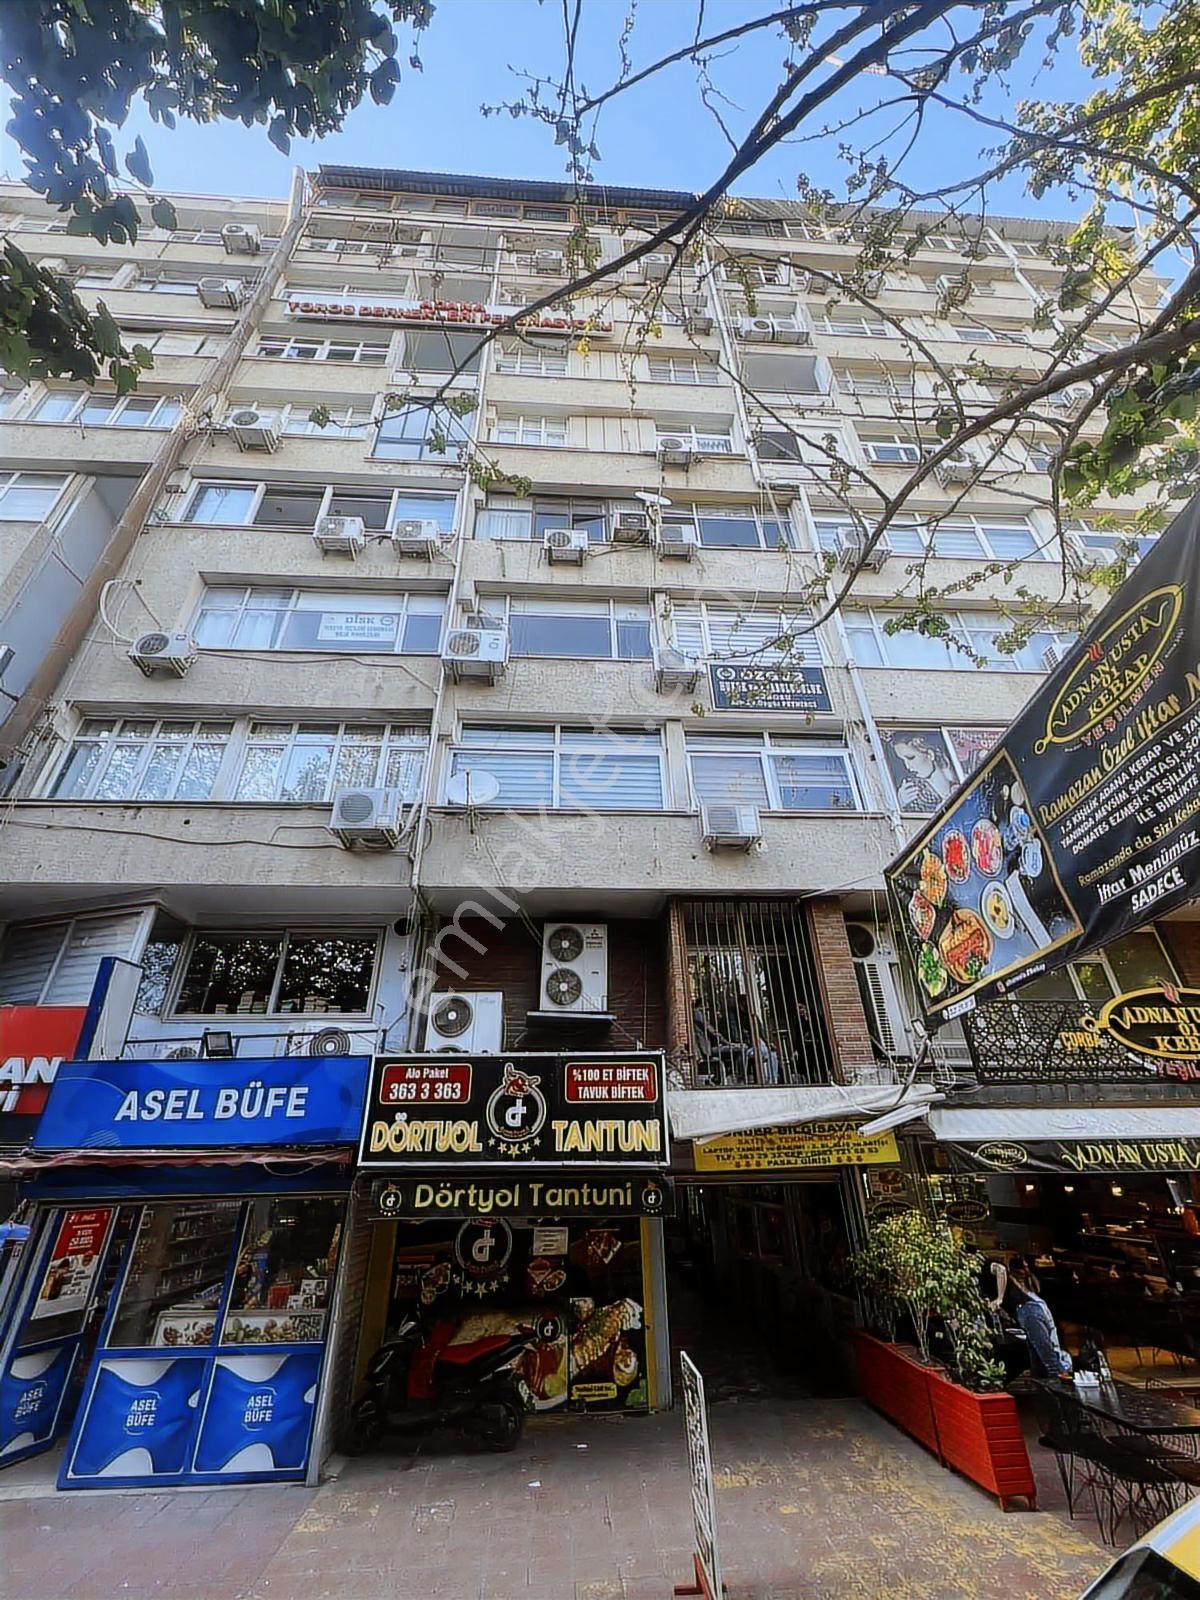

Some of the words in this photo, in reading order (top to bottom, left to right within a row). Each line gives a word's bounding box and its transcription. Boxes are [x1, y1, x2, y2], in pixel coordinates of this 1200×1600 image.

[288, 302, 355, 316] TOROS
[1053, 655, 1110, 728] ADNAN
[1109, 601, 1168, 662] USTA
[1088, 653, 1149, 719] KEBAP
[1100, 773, 1130, 801] ADANA
[1129, 744, 1162, 776] KEBAP
[1162, 731, 1184, 748] VE
[1039, 765, 1102, 826] Ramazan
[1094, 791, 1130, 821] MEVSİM
[1135, 806, 1157, 825] İLE
[1155, 773, 1199, 813] BİRLİKTE
[1072, 823, 1110, 855] DOMATES
[1129, 830, 1200, 884] Menümüz
[1131, 866, 1185, 911] SADECE
[1109, 1006, 1191, 1030] ADNAN
[405, 1068, 421, 1079] Alo
[572, 1069, 600, 1081] %100
[602, 1069, 614, 1081] ET
[616, 1067, 649, 1081] BİFTEK
[114, 1089, 204, 1121] ASEL
[214, 1081, 309, 1119] BÜFE
[389, 1083, 417, 1100] 363
[420, 1083, 430, 1100] 3
[434, 1083, 461, 1100] 363
[577, 1086, 609, 1099] TAVUK
[611, 1085, 645, 1099] BİFTEK
[370, 1112, 483, 1153] DÖRTYOL
[414, 1182, 520, 1213] Dörtyol
[529, 1182, 632, 1206] Tantuni
[21, 1388, 44, 1402] ASEL
[130, 1399, 157, 1411] ASEL
[247, 1395, 274, 1408] ASEL
[126, 1411, 155, 1427] BÜFE
[243, 1407, 272, 1423] BÜFE
